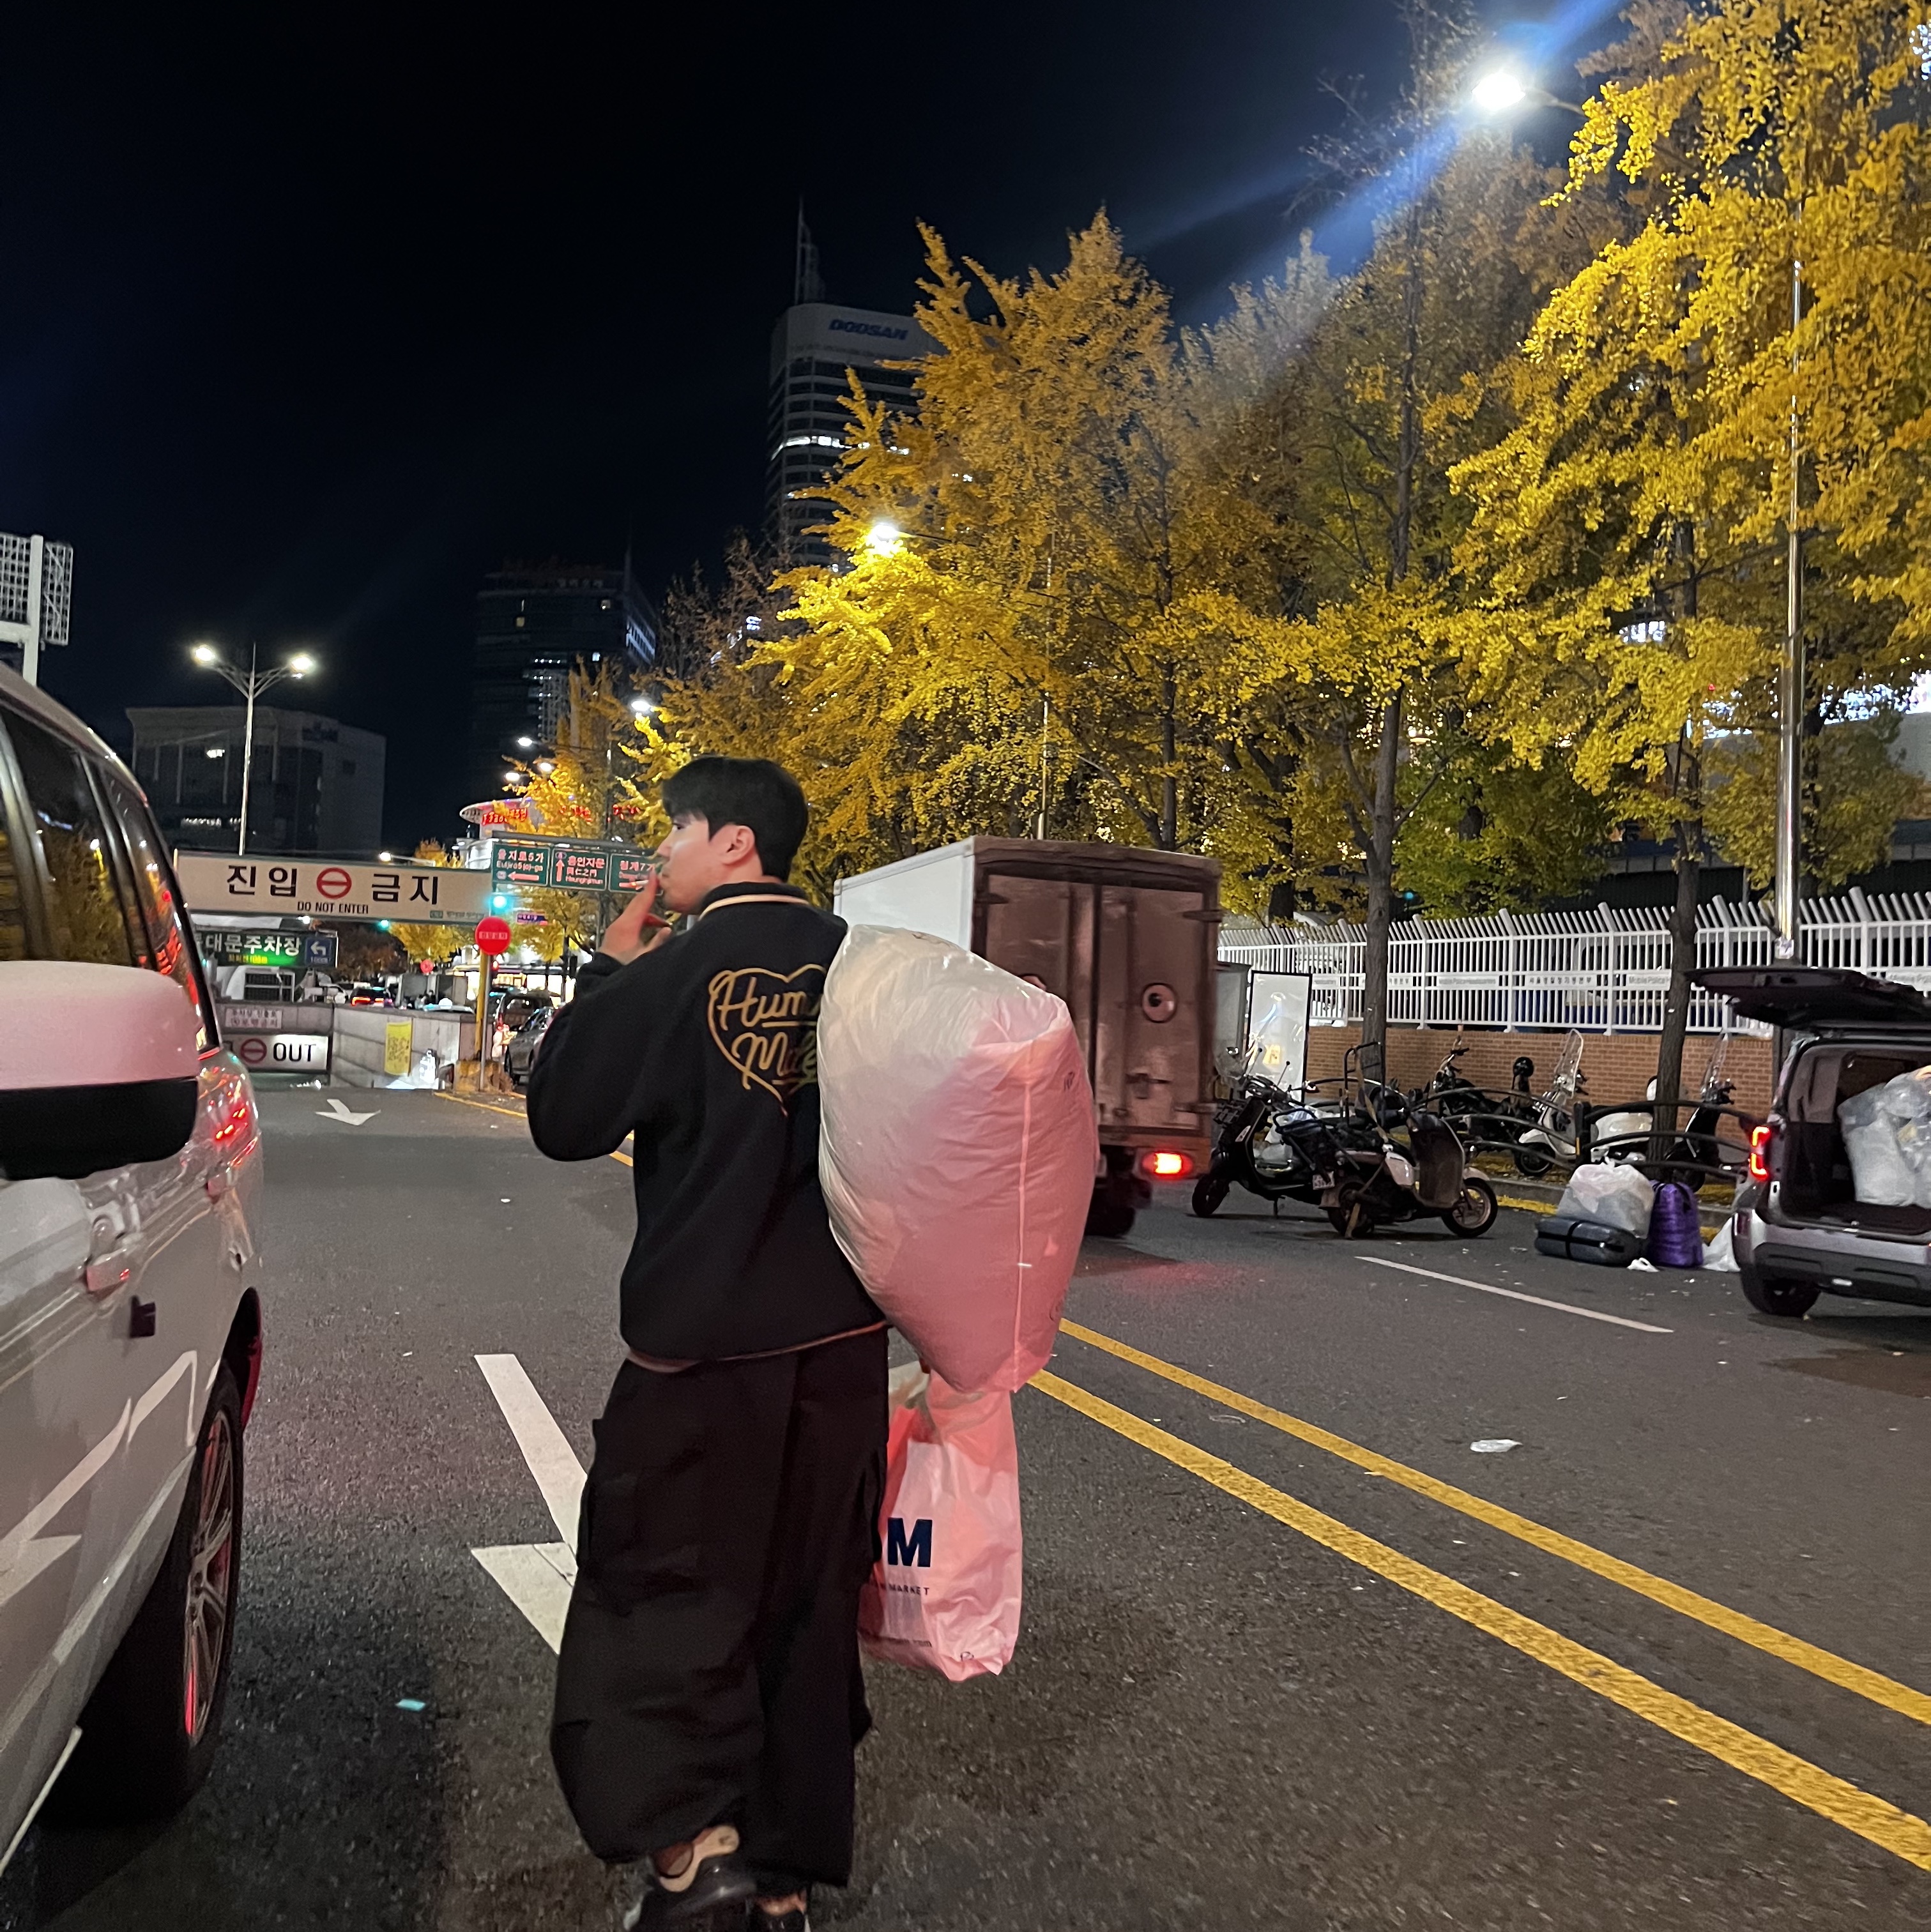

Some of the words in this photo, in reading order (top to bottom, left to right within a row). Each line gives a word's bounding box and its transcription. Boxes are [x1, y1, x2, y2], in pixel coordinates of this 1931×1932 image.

[829, 319, 908, 340] DOOSAN
[227, 865, 298, 897] 진입
[371, 873, 439, 904] 금지
[297, 901, 312, 912] DO
[315, 902, 335, 913] NOT
[339, 904, 369, 914] ENTER
[273, 1042, 317, 1062] OUT
[887, 1517, 933, 1567] M
[888, 1583, 930, 1595] MARKET
